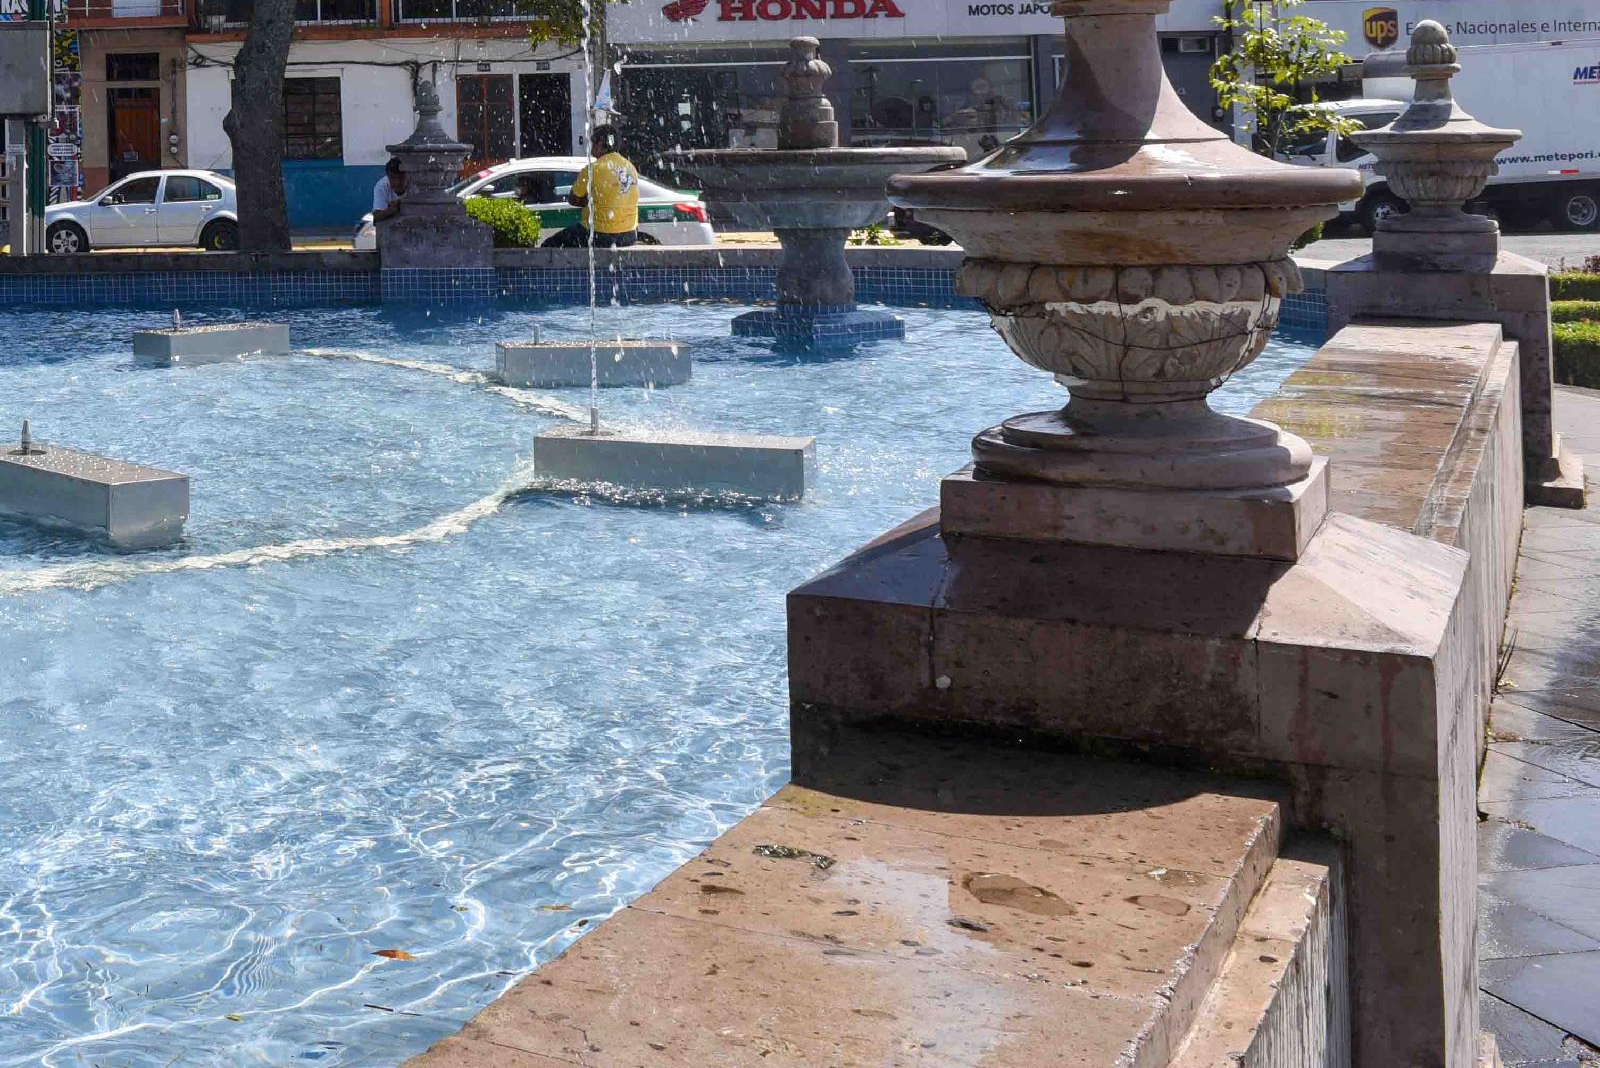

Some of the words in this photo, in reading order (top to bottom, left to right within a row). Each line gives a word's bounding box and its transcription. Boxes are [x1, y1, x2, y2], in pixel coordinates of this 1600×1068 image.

[968, 4, 1015, 16] MOTOS
[1018, 3, 1052, 15] JAPO
[1366, 19, 1397, 44] ups
[1456, 19, 1537, 35] Nacionales
[1540, 21, 1550, 33] e
[1553, 19, 1600, 33] Intern
[1496, 150, 1600, 166] www.metepori.
